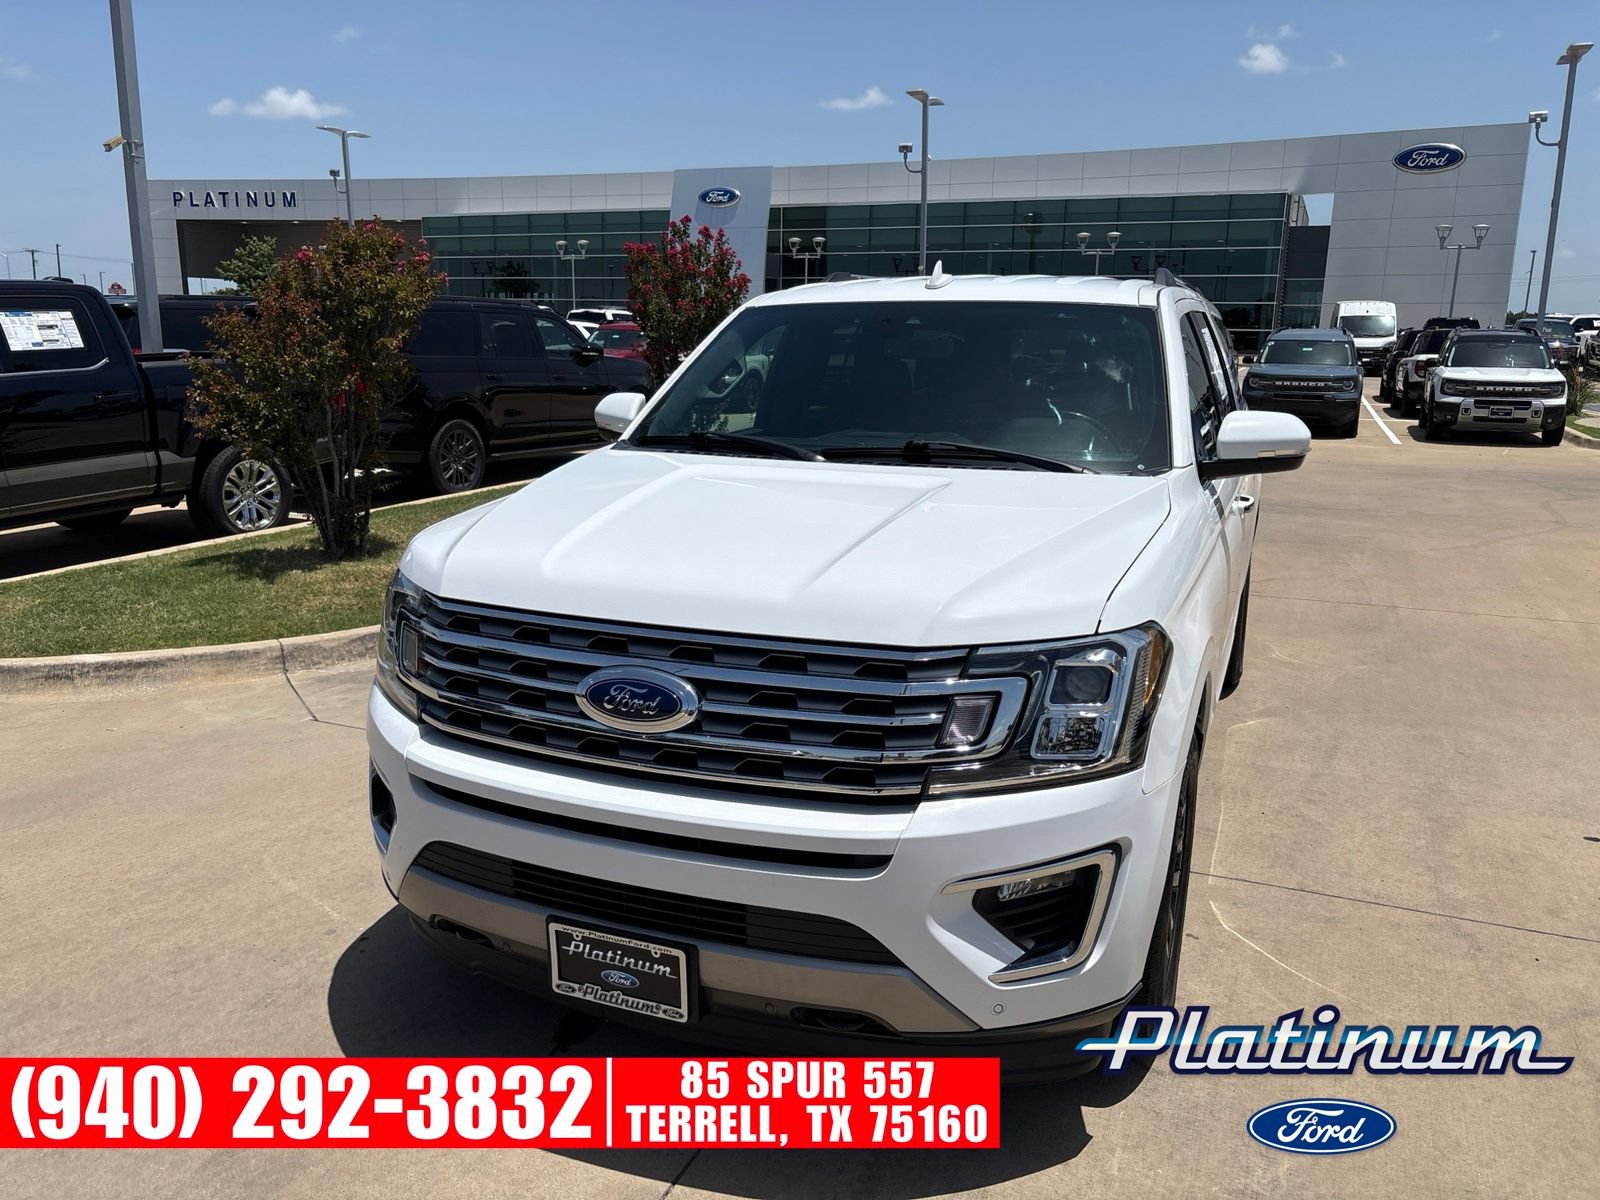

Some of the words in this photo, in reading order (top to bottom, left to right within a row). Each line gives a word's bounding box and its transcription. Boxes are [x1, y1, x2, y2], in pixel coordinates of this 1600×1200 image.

[1407, 150, 1450, 167] Ford
[172, 191, 297, 208] PLATINUM
[706, 191, 730, 203] Ford
[603, 684, 661, 715] Ford
[561, 926, 673, 955] www.PlatinumFord.com
[562, 941, 678, 979] Platinum
[608, 973, 631, 986] Ford
[583, 984, 656, 1014] Platinum
